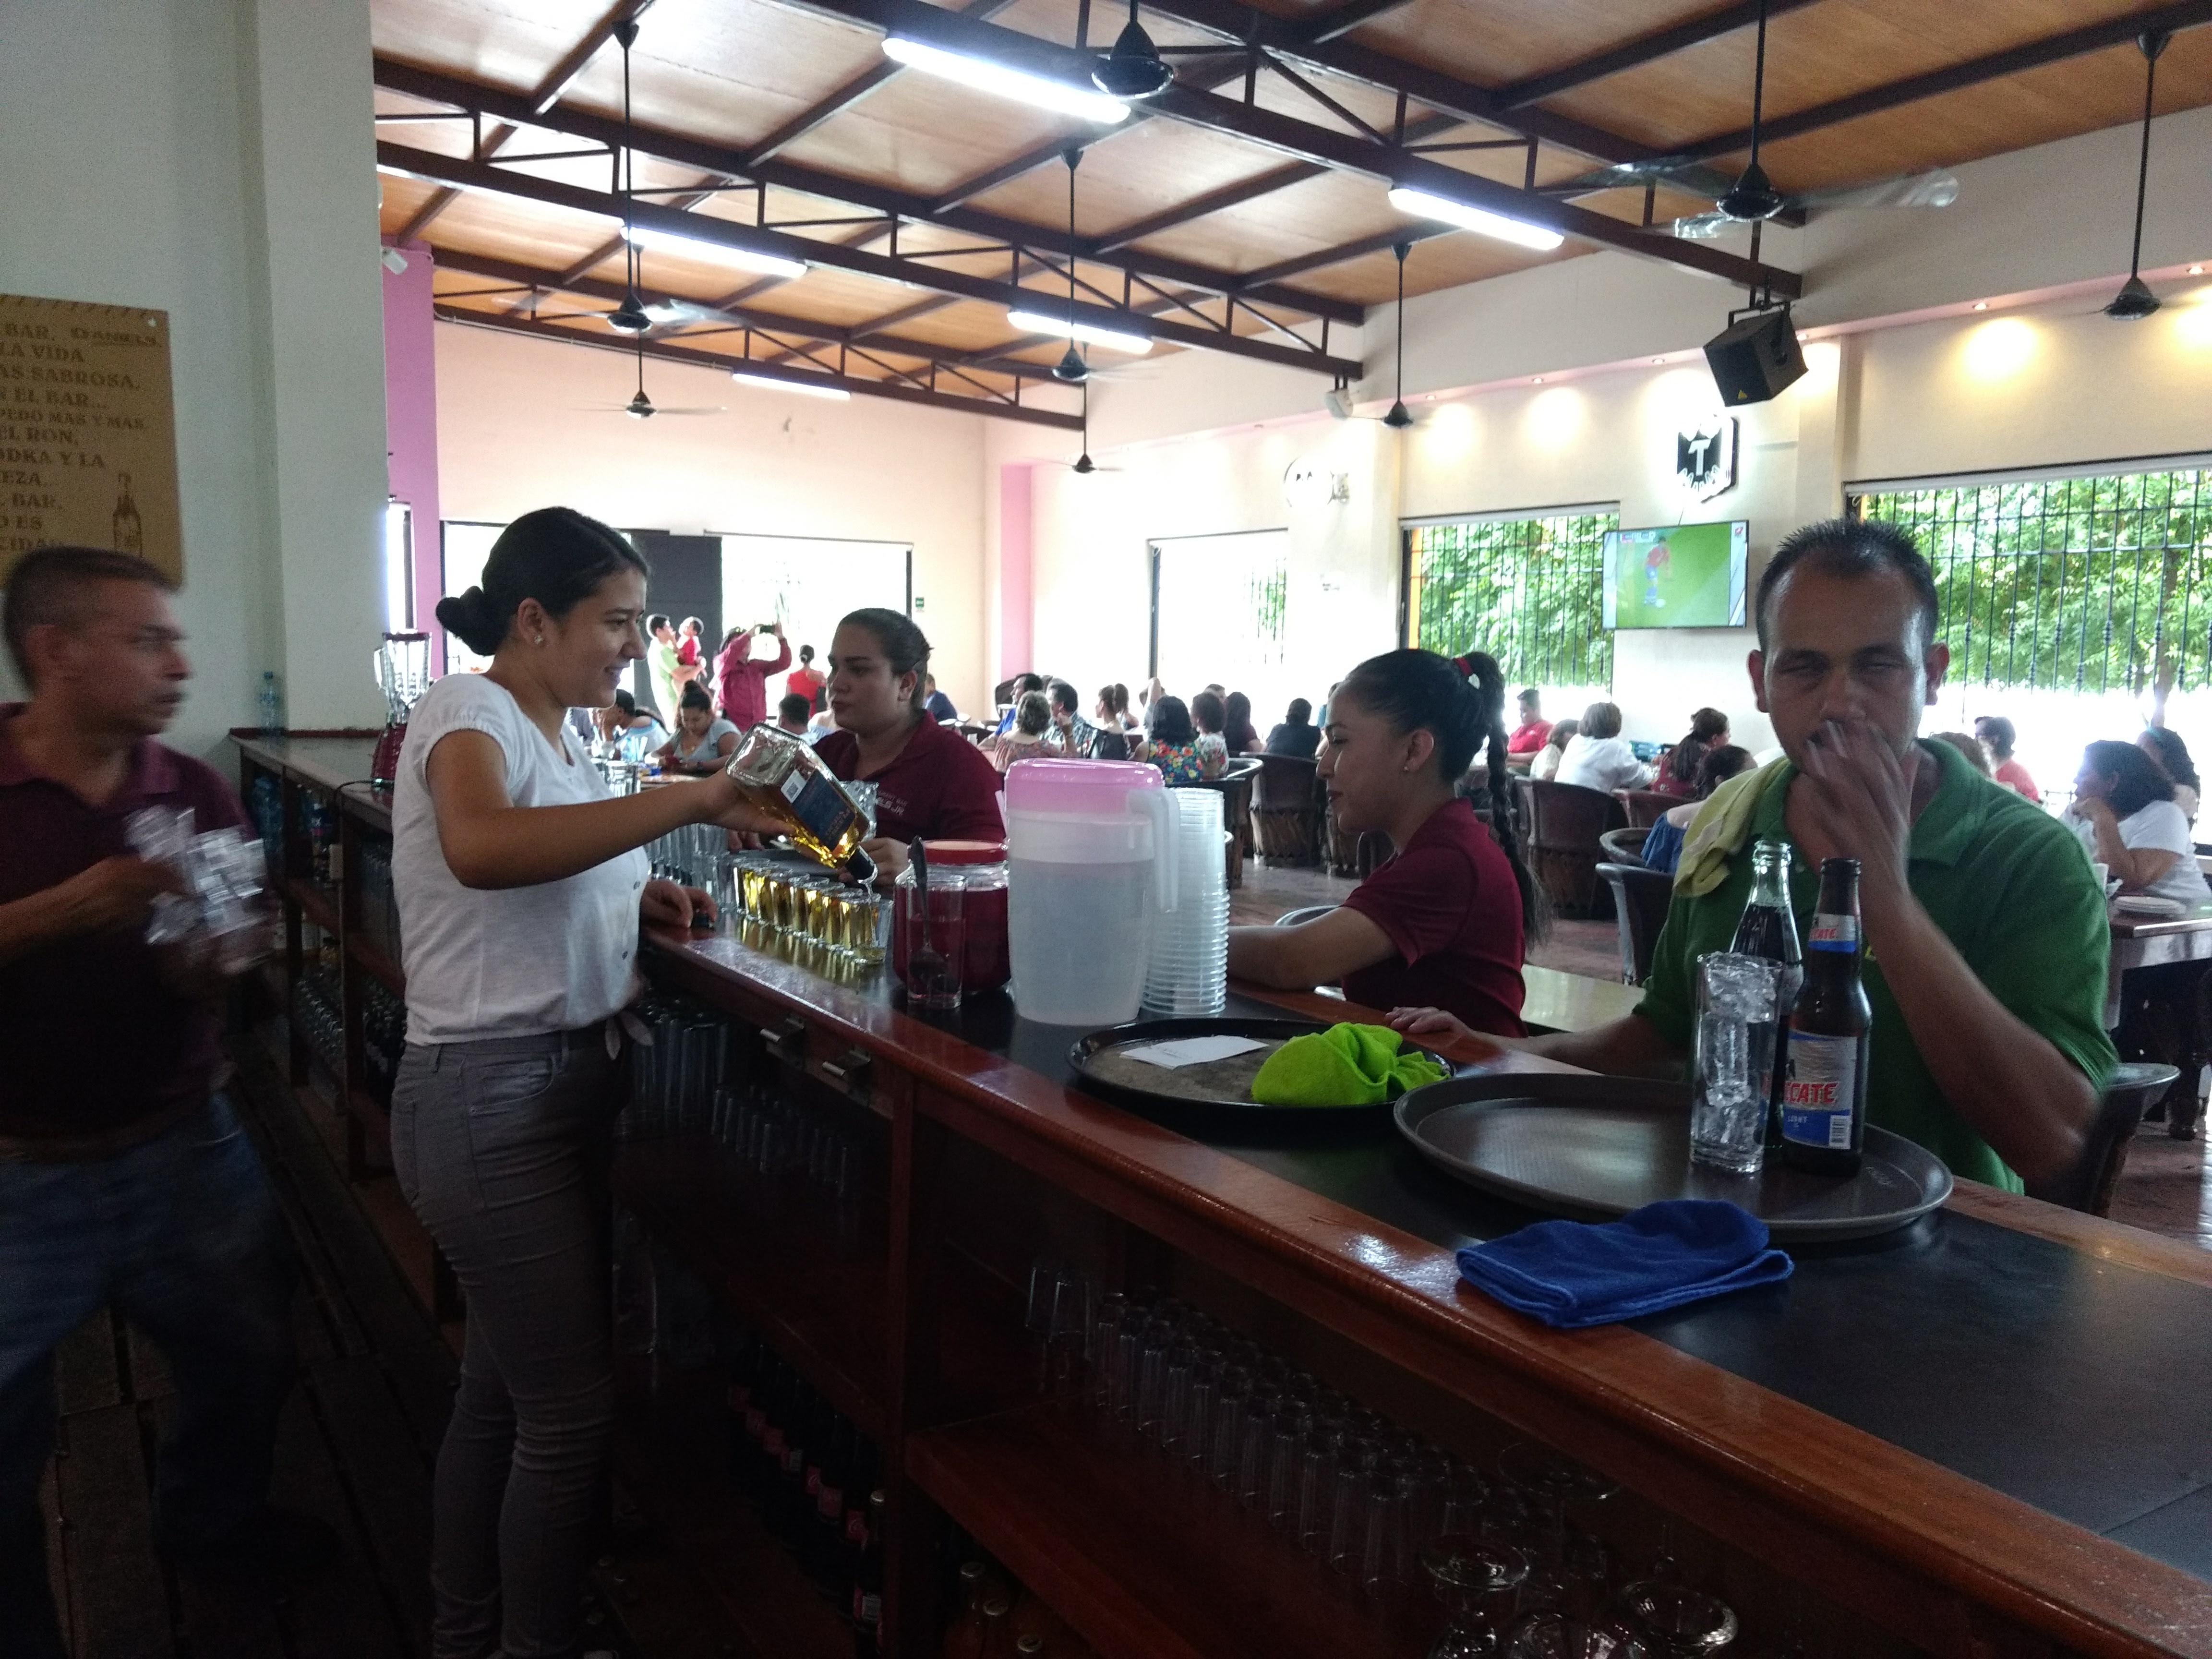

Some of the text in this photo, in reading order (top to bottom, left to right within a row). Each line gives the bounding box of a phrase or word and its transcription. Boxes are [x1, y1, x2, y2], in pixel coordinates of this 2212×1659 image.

[31, 344, 85, 362] VIDA
[49, 411, 86, 426] MAS
[107, 417, 144, 429] MAS
[59, 451, 72, 466] Y
[78, 452, 106, 469] LA
